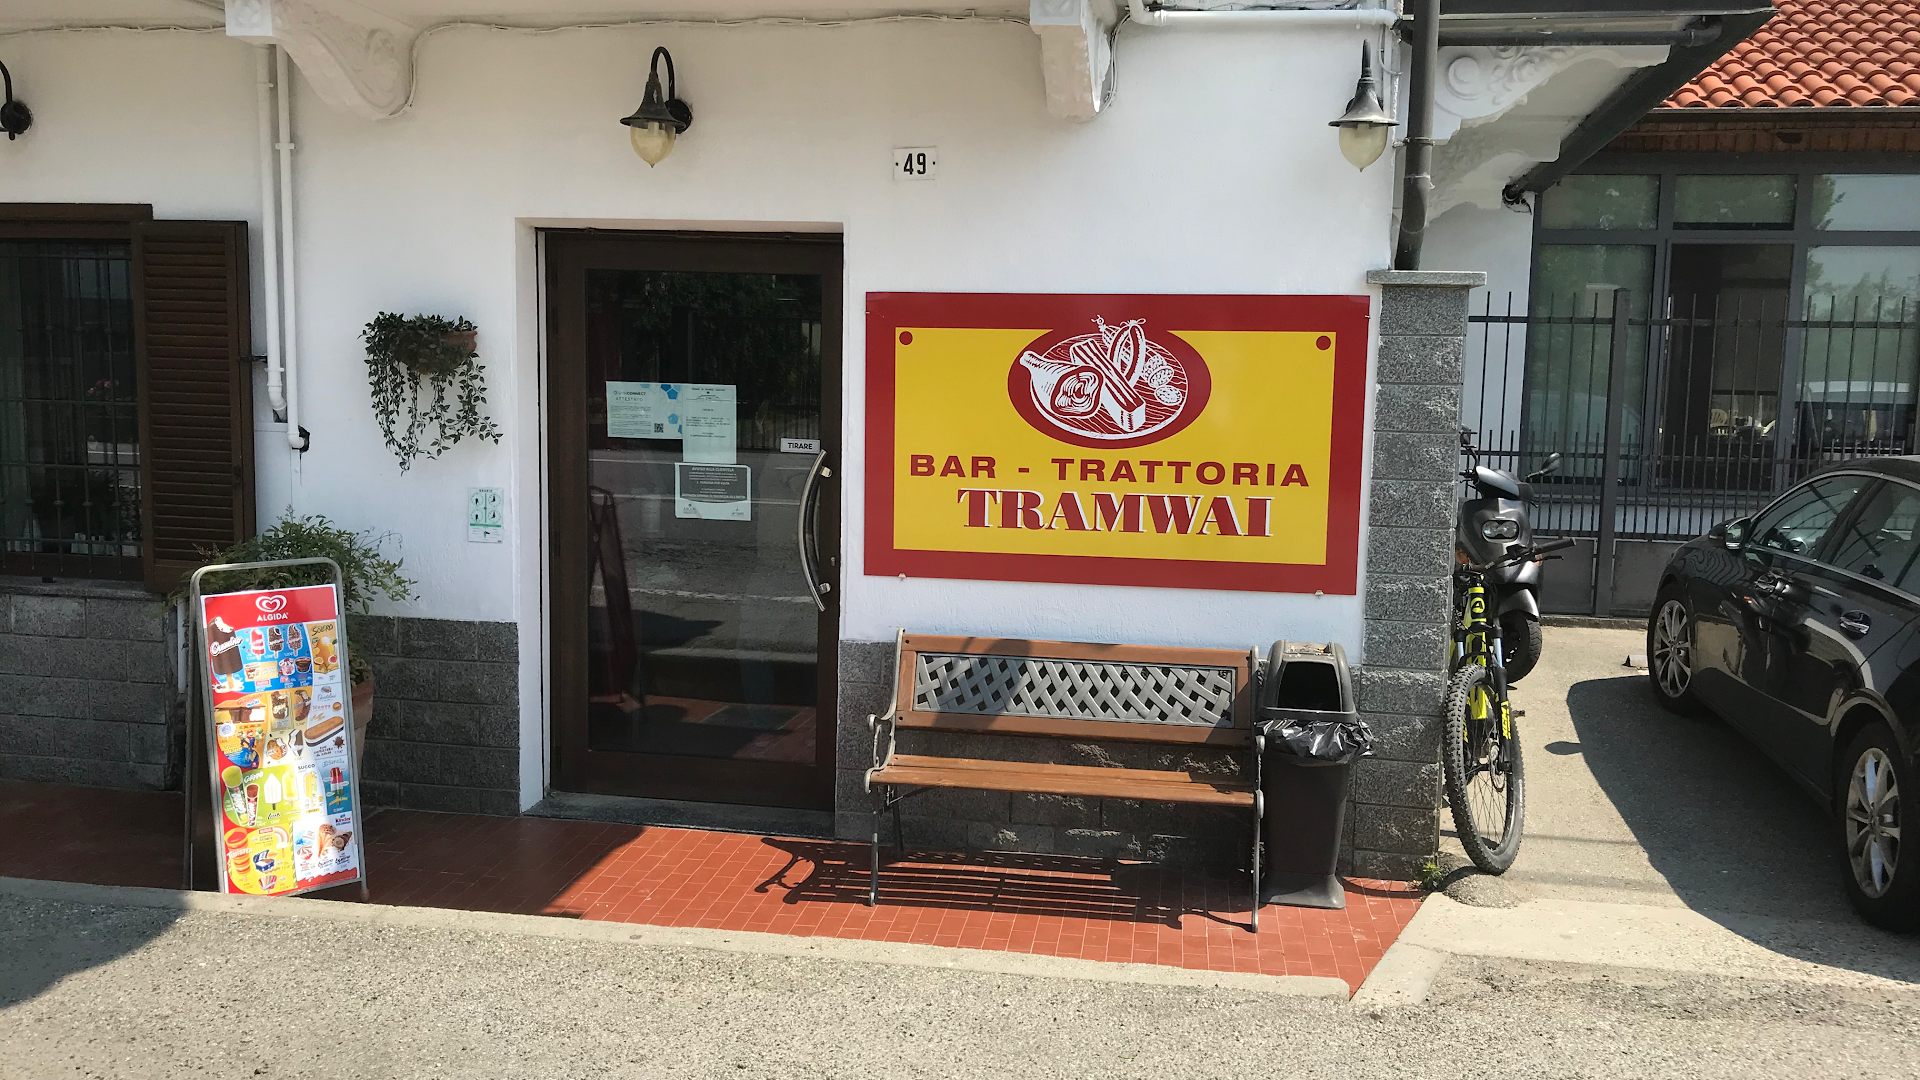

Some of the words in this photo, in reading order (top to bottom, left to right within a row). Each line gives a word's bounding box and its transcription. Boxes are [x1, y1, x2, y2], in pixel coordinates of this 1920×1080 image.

[903, 152, 927, 175] 49
[787, 442, 813, 450] TIRARE
[909, 454, 996, 479] BAR
[1050, 457, 1310, 488] TRATTORIA
[957, 488, 1275, 538] TRAMWAI
[256, 612, 288, 622] ALGIDA
